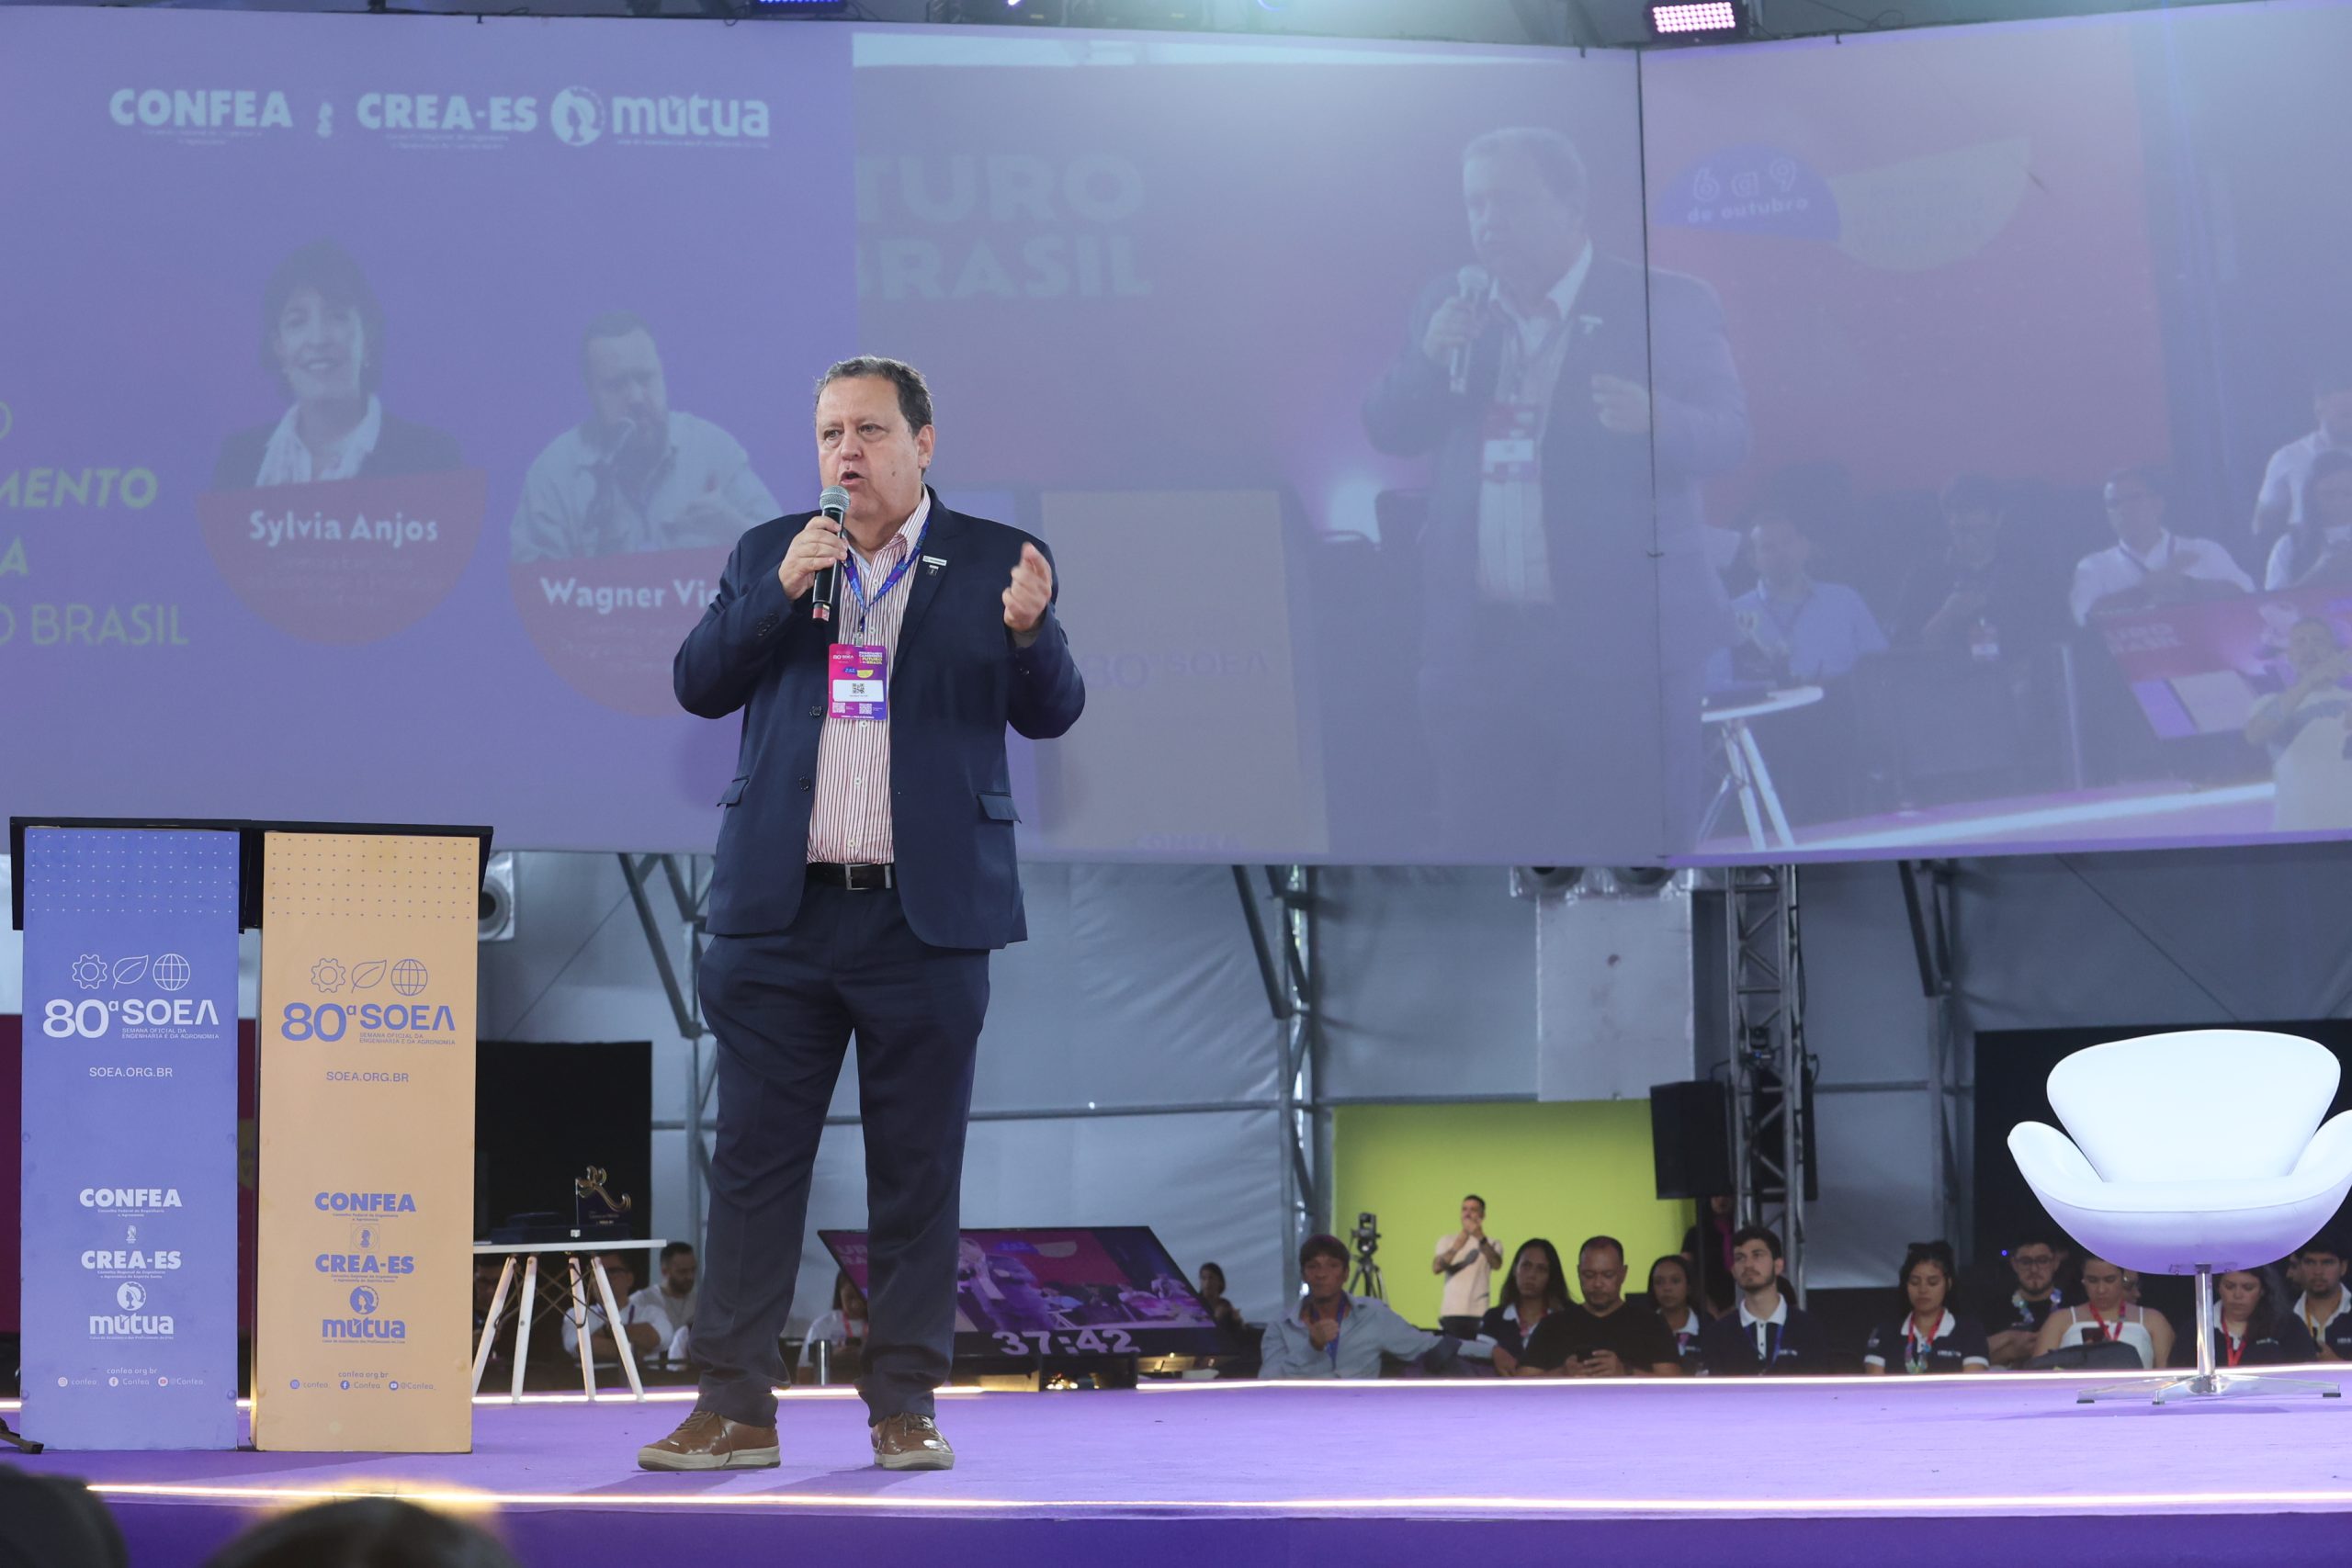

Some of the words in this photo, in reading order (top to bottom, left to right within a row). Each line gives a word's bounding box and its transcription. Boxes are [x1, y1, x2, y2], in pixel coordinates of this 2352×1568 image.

[109, 89, 293, 128] CONFEA
[356, 92, 538, 132] CREA-ES
[1693, 166, 1721, 202] 6
[1769, 157, 1797, 192] 9
[1687, 206, 1713, 224] de
[1720, 197, 1809, 220] outubro
[249, 510, 342, 547] Sylvia
[349, 512, 439, 548] Anjos
[539, 577, 666, 615] Wagner
[31, 603, 190, 646] BRASIL
[89, 1066, 173, 1077] SOEA.ORG.BR
[326, 1071, 409, 1082] SOEA.ORG.BR
[79, 1188, 183, 1208] CONFEA
[314, 1192, 417, 1213] CONFEA
[81, 1250, 182, 1270] CREA-ES
[315, 1254, 414, 1274] CREA-ES
[991, 1329, 1141, 1356] 37:42
